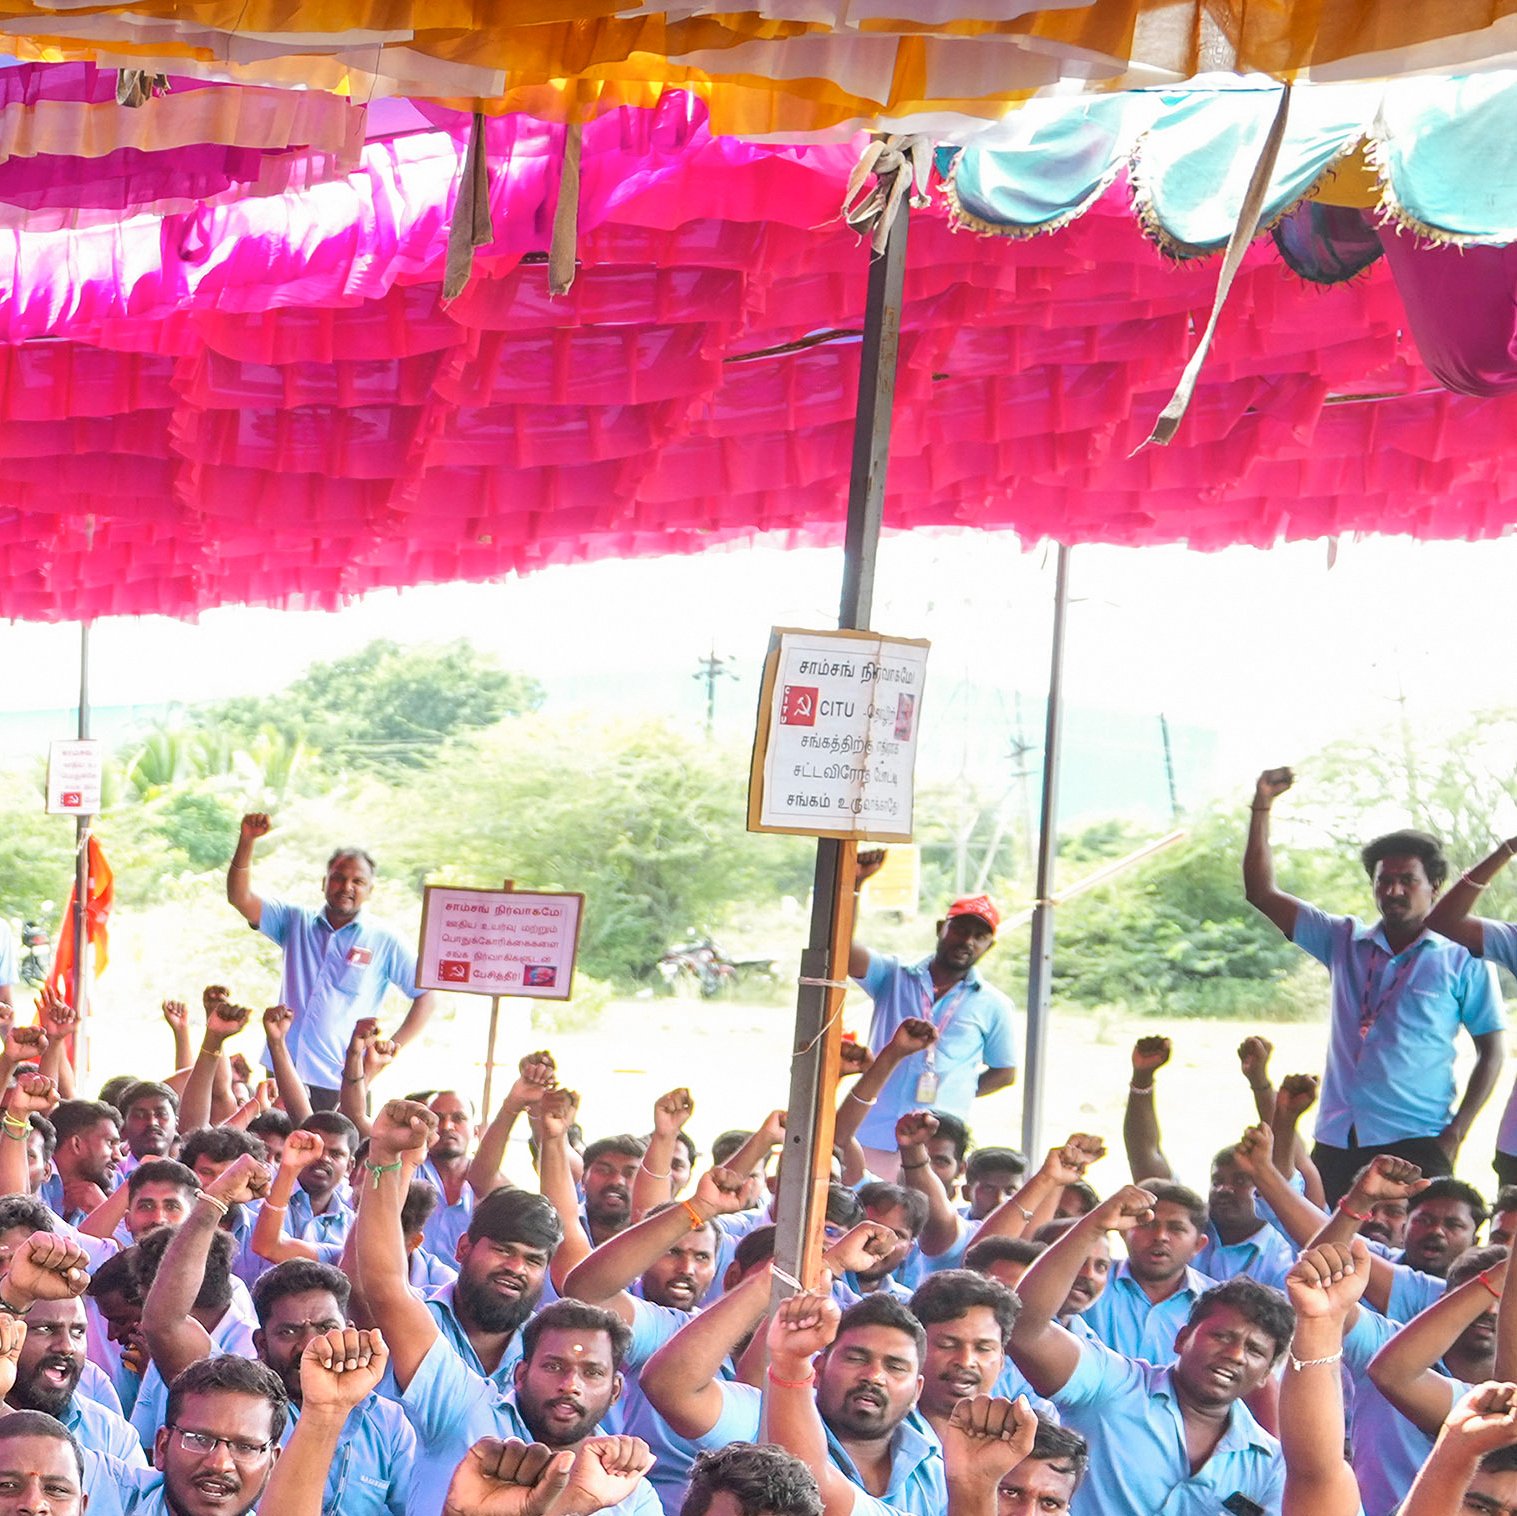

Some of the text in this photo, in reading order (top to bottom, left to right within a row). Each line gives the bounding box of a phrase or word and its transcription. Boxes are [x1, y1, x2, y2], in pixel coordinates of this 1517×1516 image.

[799, 658, 855, 678] சாம்சங்
[820, 700, 855, 718] CITU
[787, 791, 831, 809] சங்கம்
[445, 902, 563, 918] சாம்சங் நிர்வாகமே!
